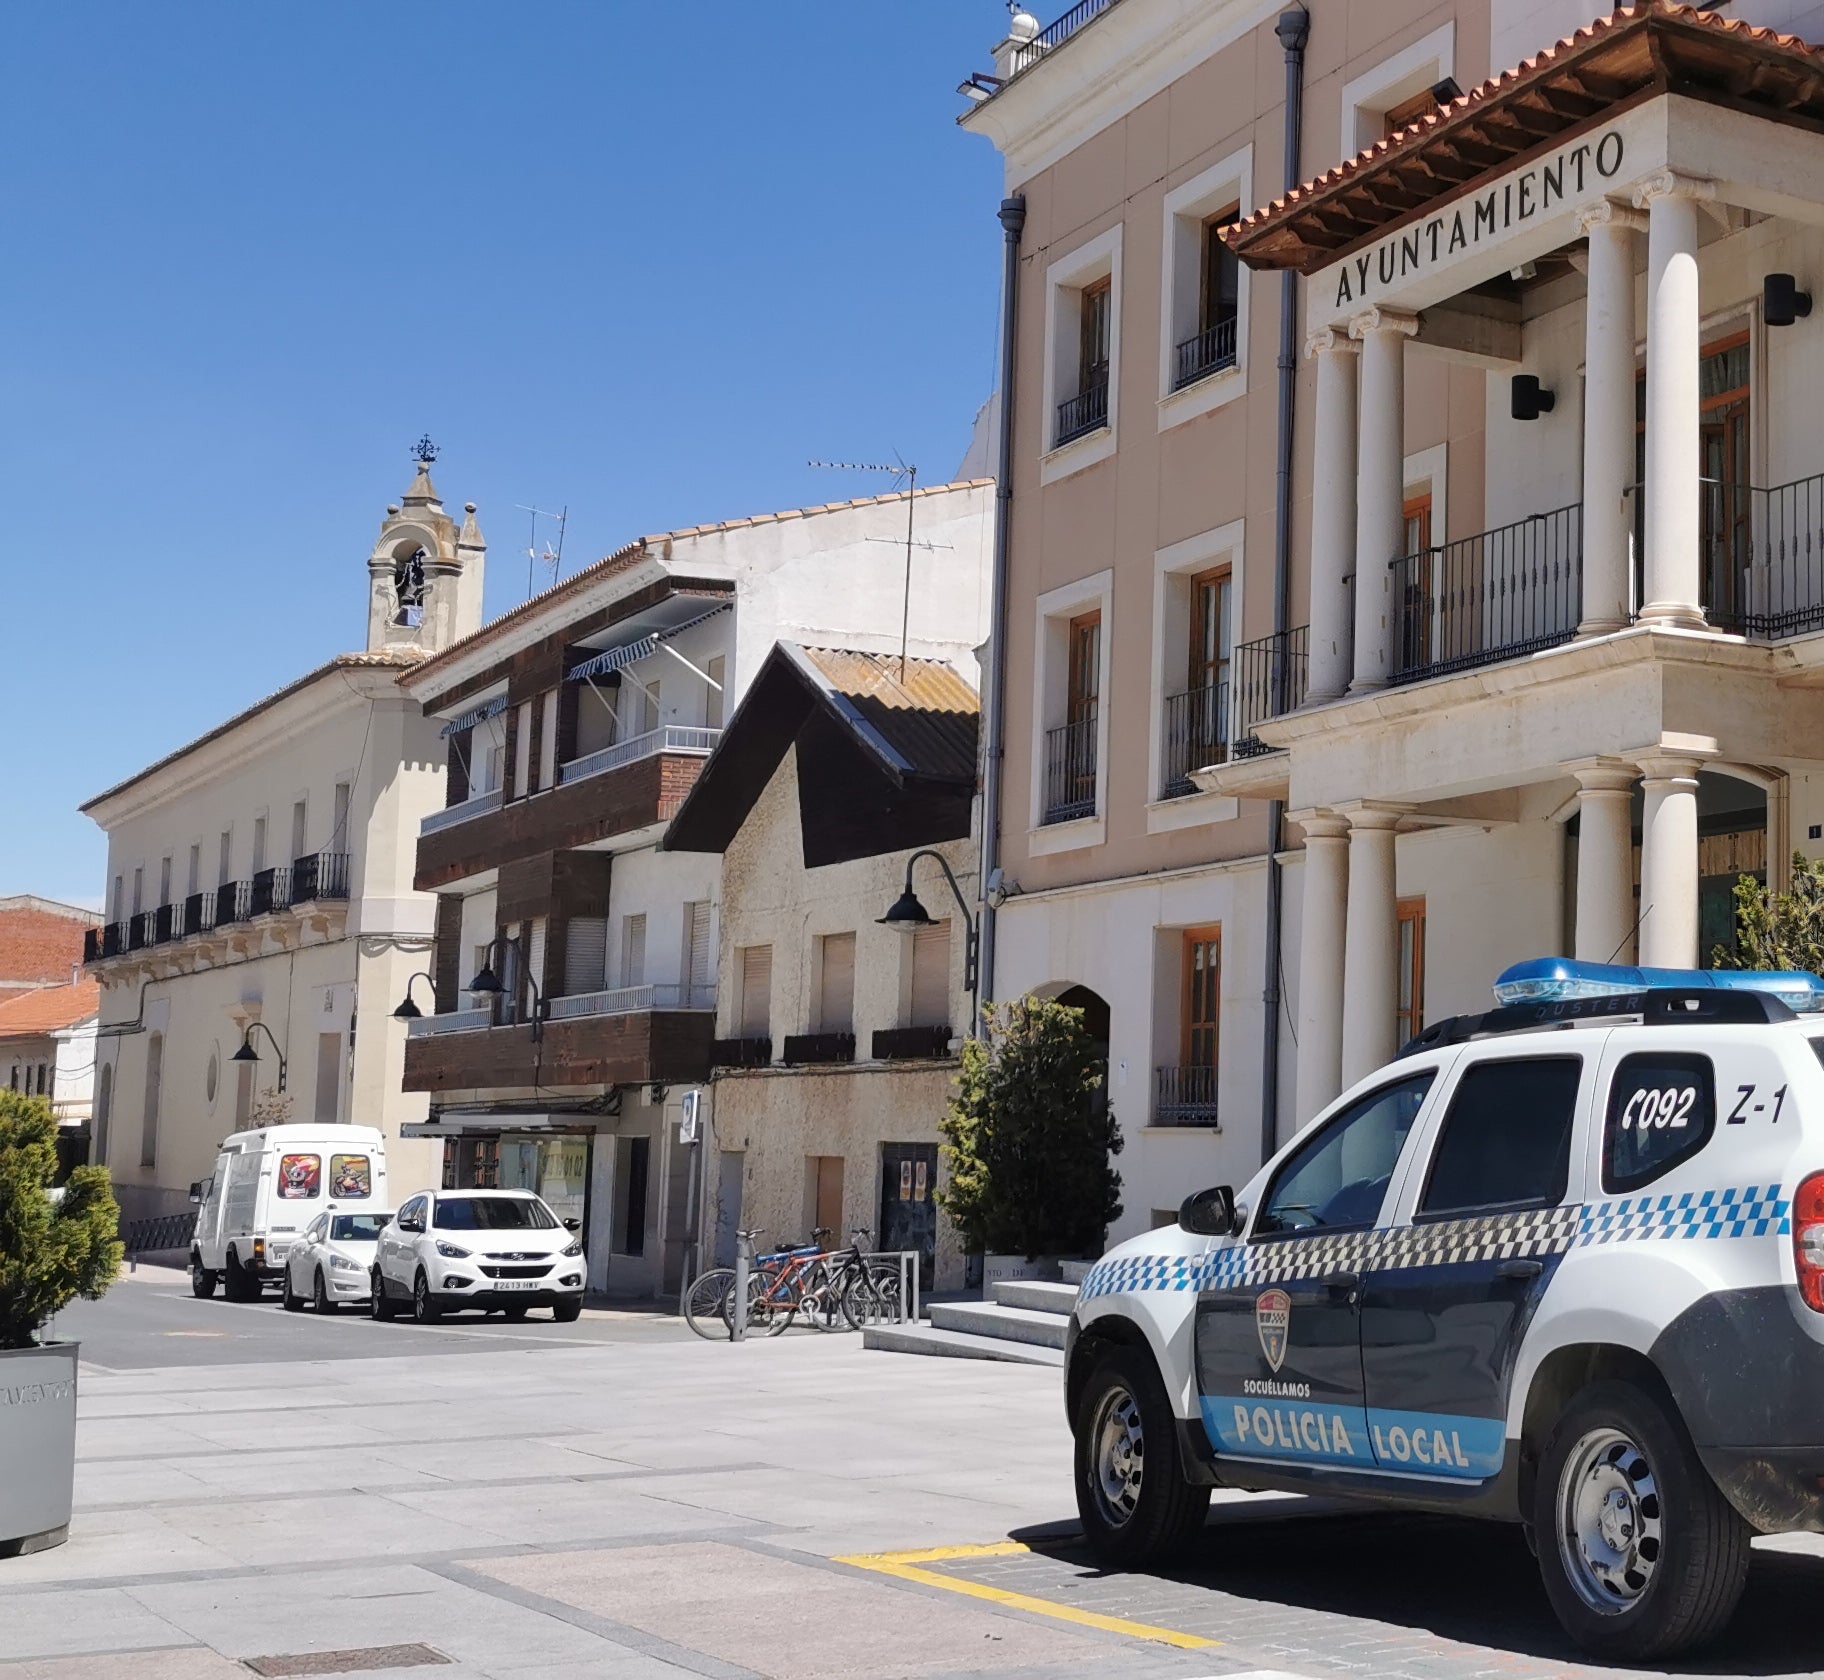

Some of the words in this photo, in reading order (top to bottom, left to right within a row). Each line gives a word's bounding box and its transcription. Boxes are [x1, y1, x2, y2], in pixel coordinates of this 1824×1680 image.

[1336, 131, 1624, 308] AYUNTAMIENTO
[1535, 996, 1639, 1019] DUSTER
[1726, 1083, 1788, 1125] Z-1
[1243, 1378, 1310, 1398] SOCUÉLLAMOS
[1234, 1405, 1354, 1456] POLICIA
[1373, 1425, 1469, 1468] LOCAL
